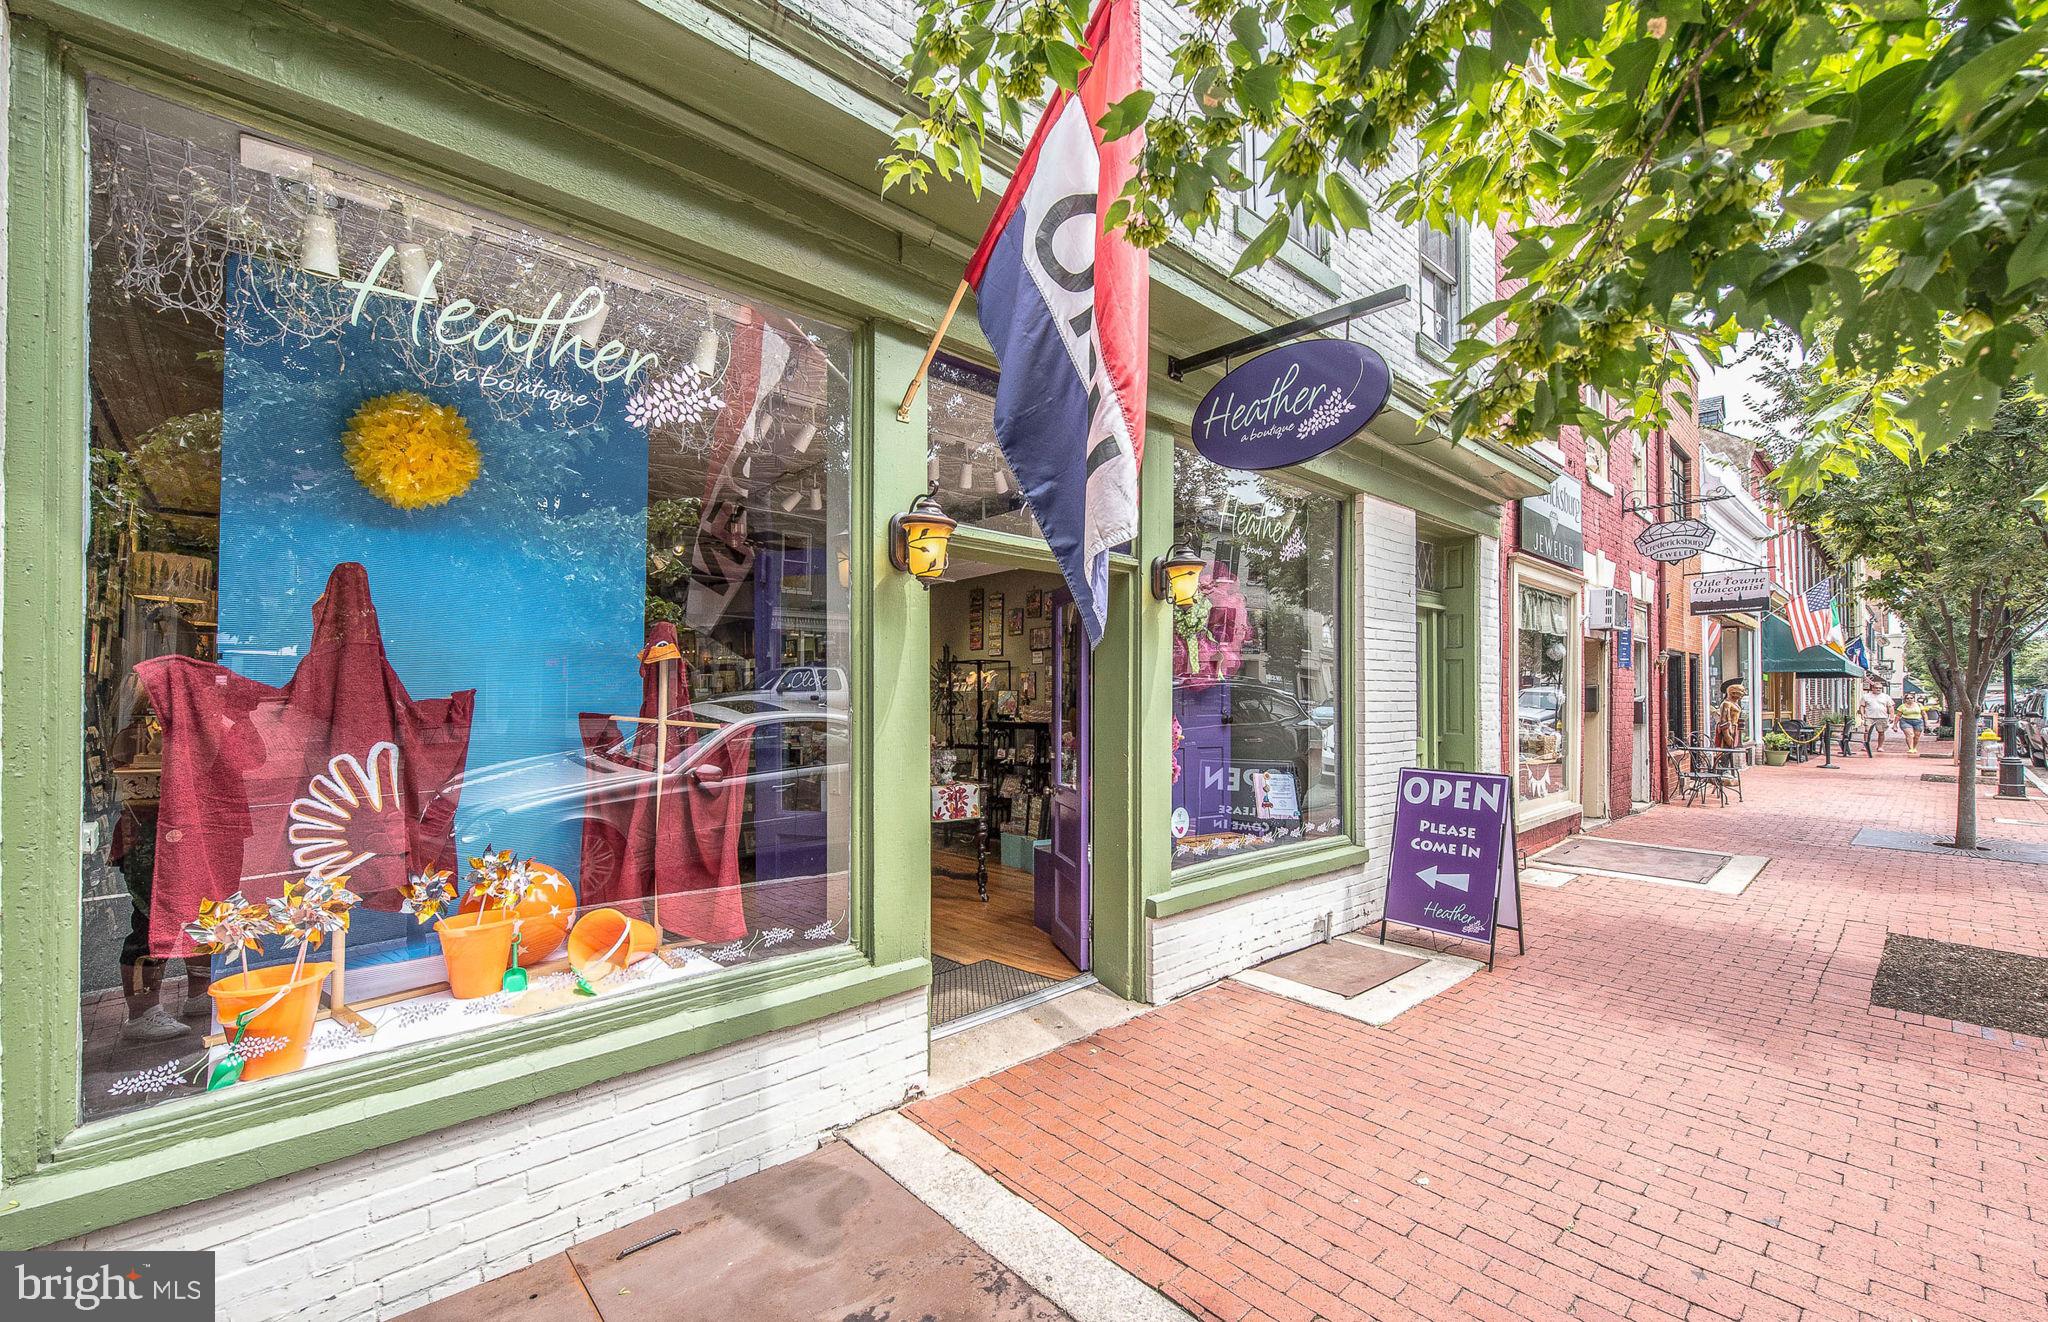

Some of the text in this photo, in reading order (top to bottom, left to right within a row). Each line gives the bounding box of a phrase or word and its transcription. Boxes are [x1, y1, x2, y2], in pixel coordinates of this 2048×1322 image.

[343, 245, 659, 386] Heather
[454, 366, 591, 411] a boutique
[1203, 363, 1327, 440] Heather
[1240, 422, 1296, 443] a boutique
[1218, 493, 1291, 544] Heather
[1246, 541, 1272, 560] boutique
[1533, 532, 1574, 564] JEWELER
[1645, 538, 1704, 553] Fredericksburg
[1655, 549, 1695, 559] JEWELER
[1693, 577, 1766, 588] Olde Towne
[1693, 583, 1764, 595] Tobacconist
[1403, 776, 1502, 813] OPEN
[1419, 820, 1476, 840] PLEASE
[1410, 837, 1481, 860] COME IN
[1423, 901, 1476, 924] Heather
